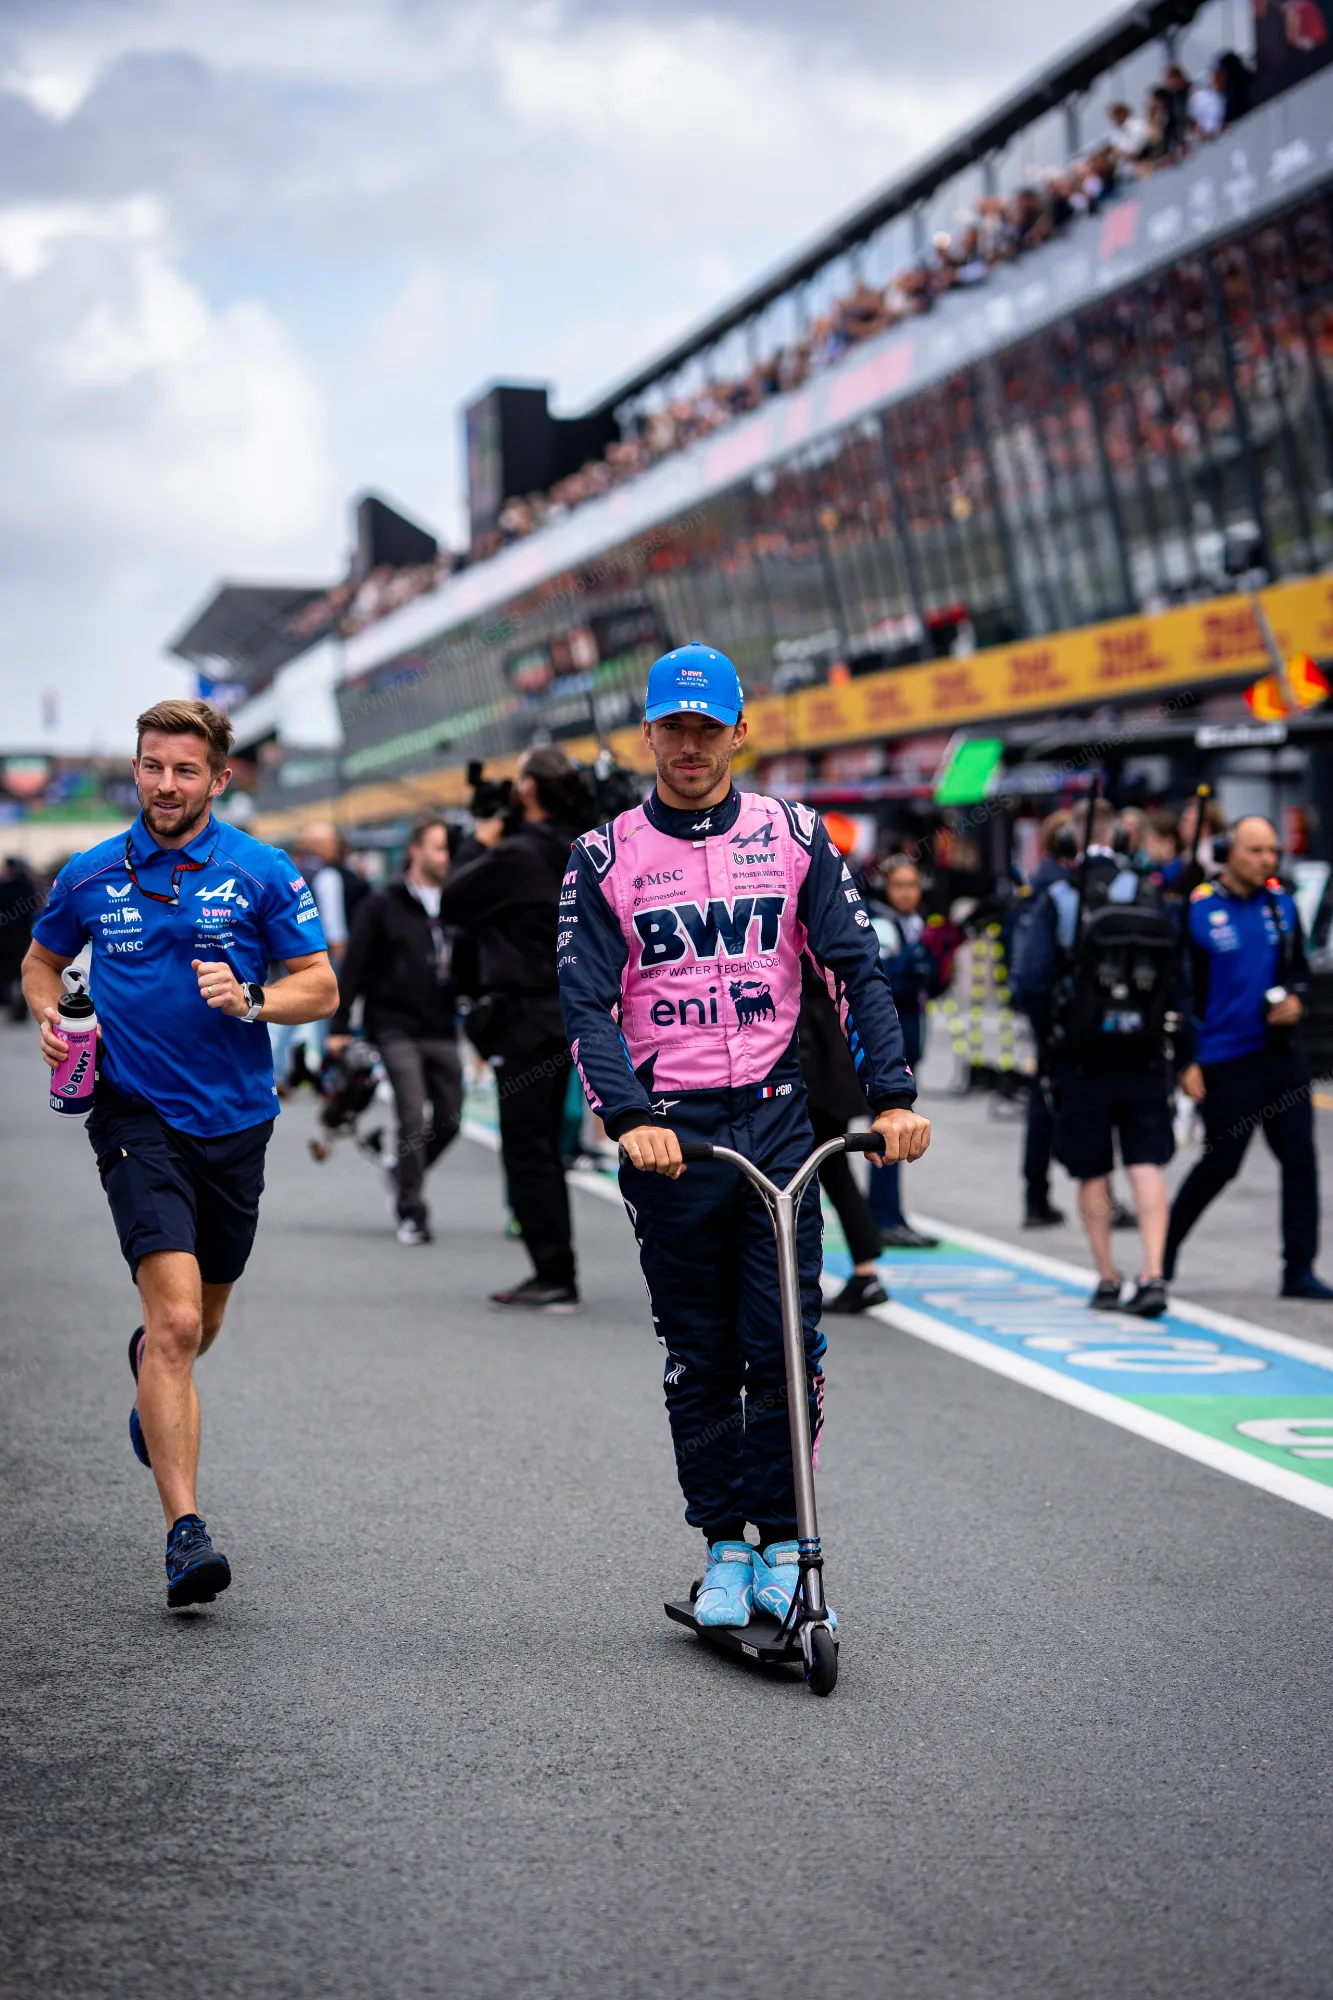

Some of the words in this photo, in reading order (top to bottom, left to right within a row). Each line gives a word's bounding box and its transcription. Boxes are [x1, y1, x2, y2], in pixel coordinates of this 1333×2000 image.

[745, 852, 776, 865] BWT
[646, 869, 683, 885] MSC
[642, 889, 686, 903] businessolver
[100, 908, 121, 923] eni
[211, 909, 232, 918] BWT
[108, 926, 143, 935] businessolver
[632, 894, 788, 970] BWT
[115, 940, 144, 953] MSC
[641, 968, 666, 979] BEST
[669, 965, 711, 977] WATER
[714, 957, 781, 974] TECHNOLOGY
[650, 986, 718, 1027] eni
[70, 1049, 92, 1084] BWT
